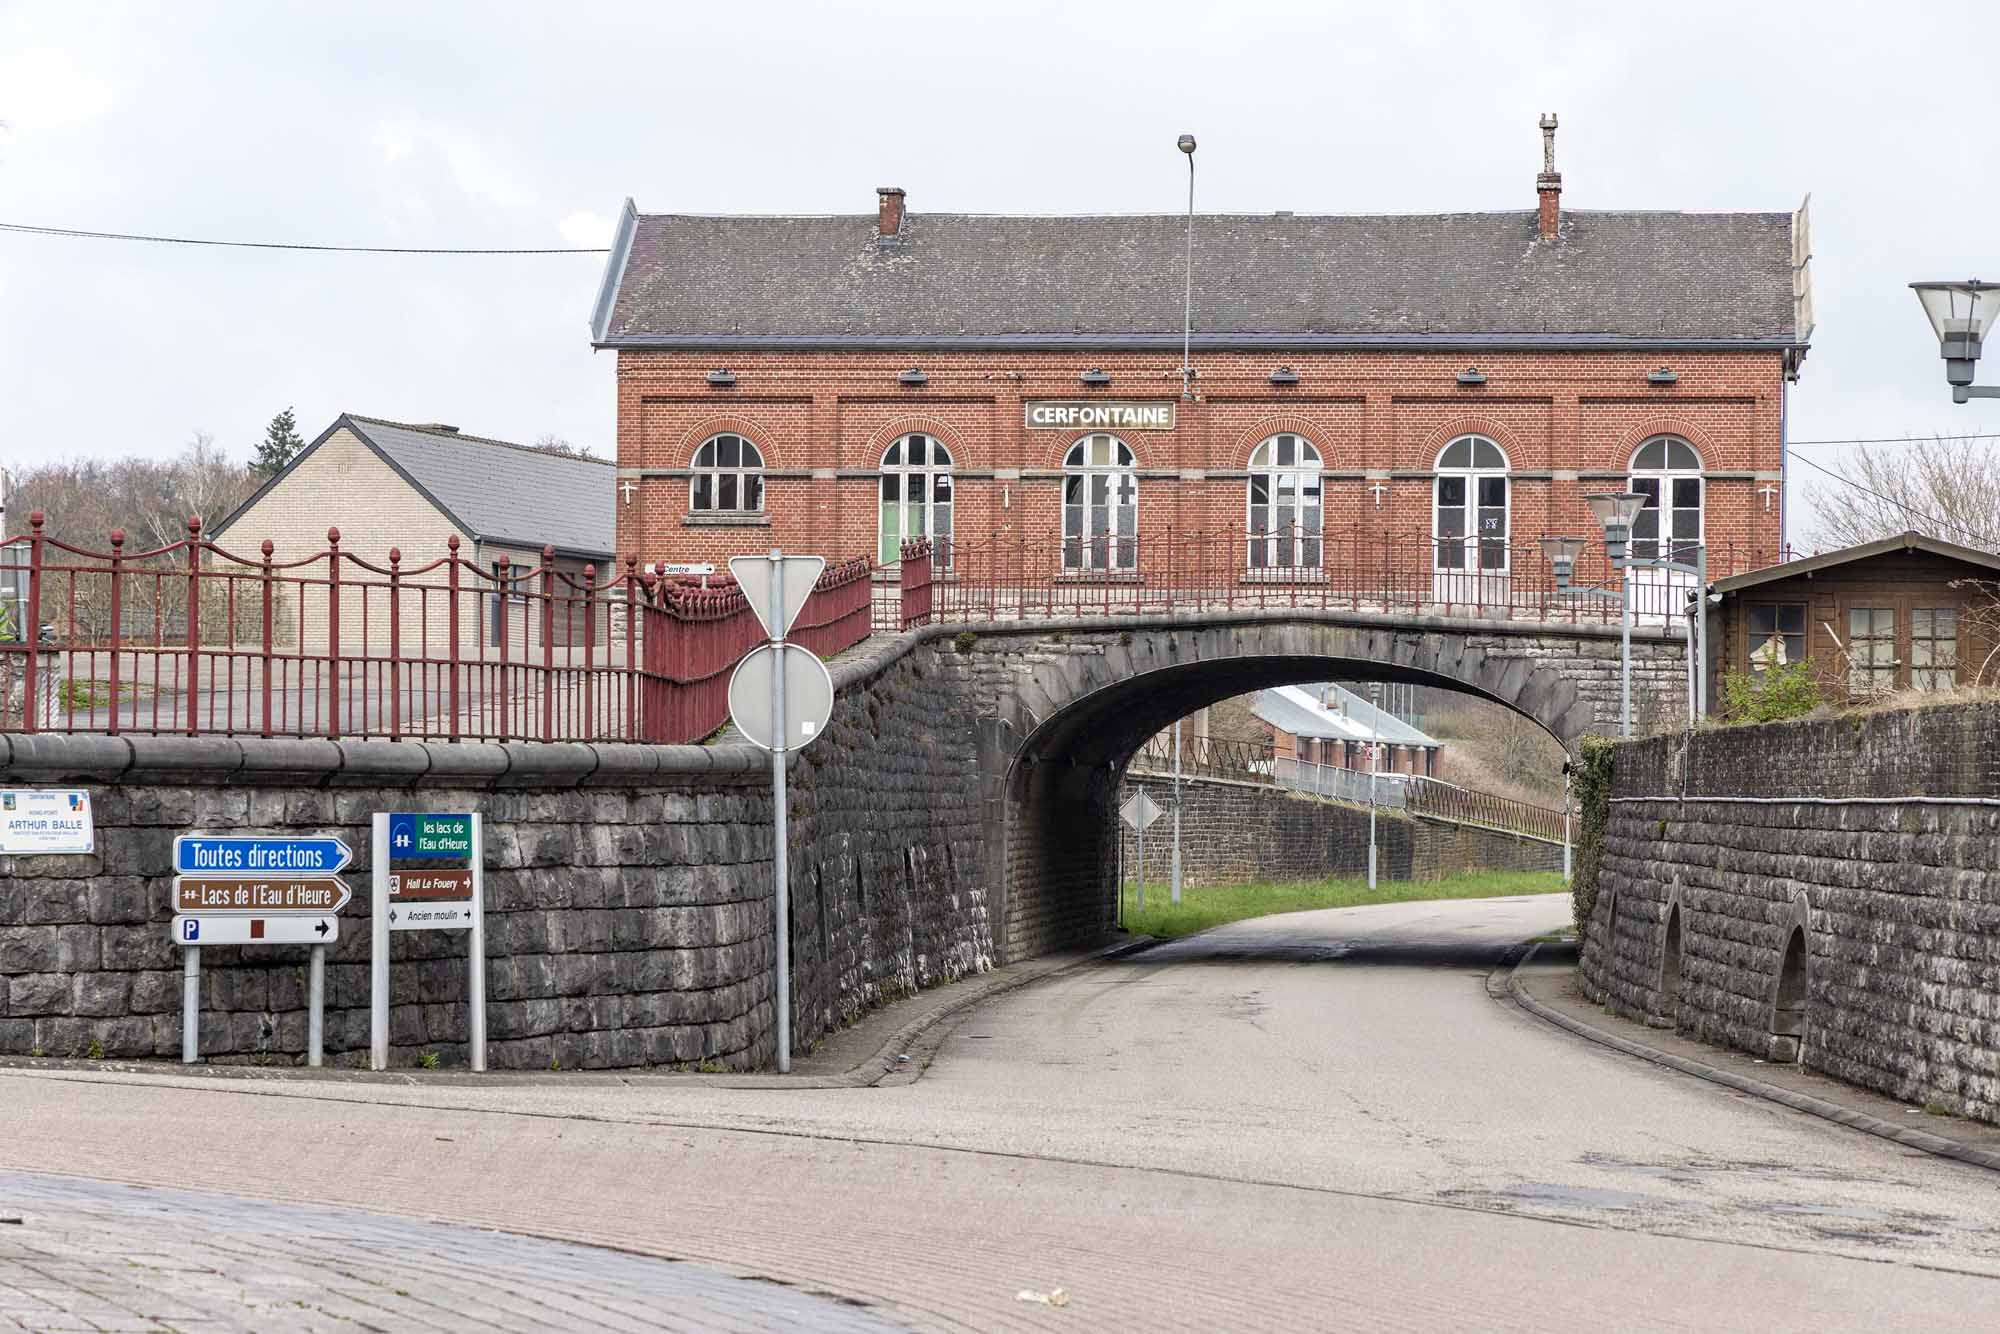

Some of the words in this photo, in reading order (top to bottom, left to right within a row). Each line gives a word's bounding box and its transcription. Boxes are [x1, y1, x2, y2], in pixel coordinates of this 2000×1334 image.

[1032, 407, 1169, 423] CERFONTAINE
[8, 820, 48, 830] ARTHUR
[52, 820, 83, 830] BALLE
[423, 821, 434, 834] les
[436, 822, 451, 834] lacs
[453, 822, 464, 834] de
[419, 838, 437, 850] l'Eau
[438, 838, 468, 850] d'Heure
[192, 843, 242, 867] Toutes
[248, 844, 323, 867] directions
[406, 878, 420, 889] Hall
[422, 878, 432, 889] Le
[201, 884, 231, 905] Lacs
[234, 885, 249, 905] de
[253, 884, 282, 905] l'Eau
[286, 884, 332, 905] d'Heure
[407, 911, 433, 921] Ancien
[434, 911, 459, 921] moulin
[186, 921, 196, 939] P
